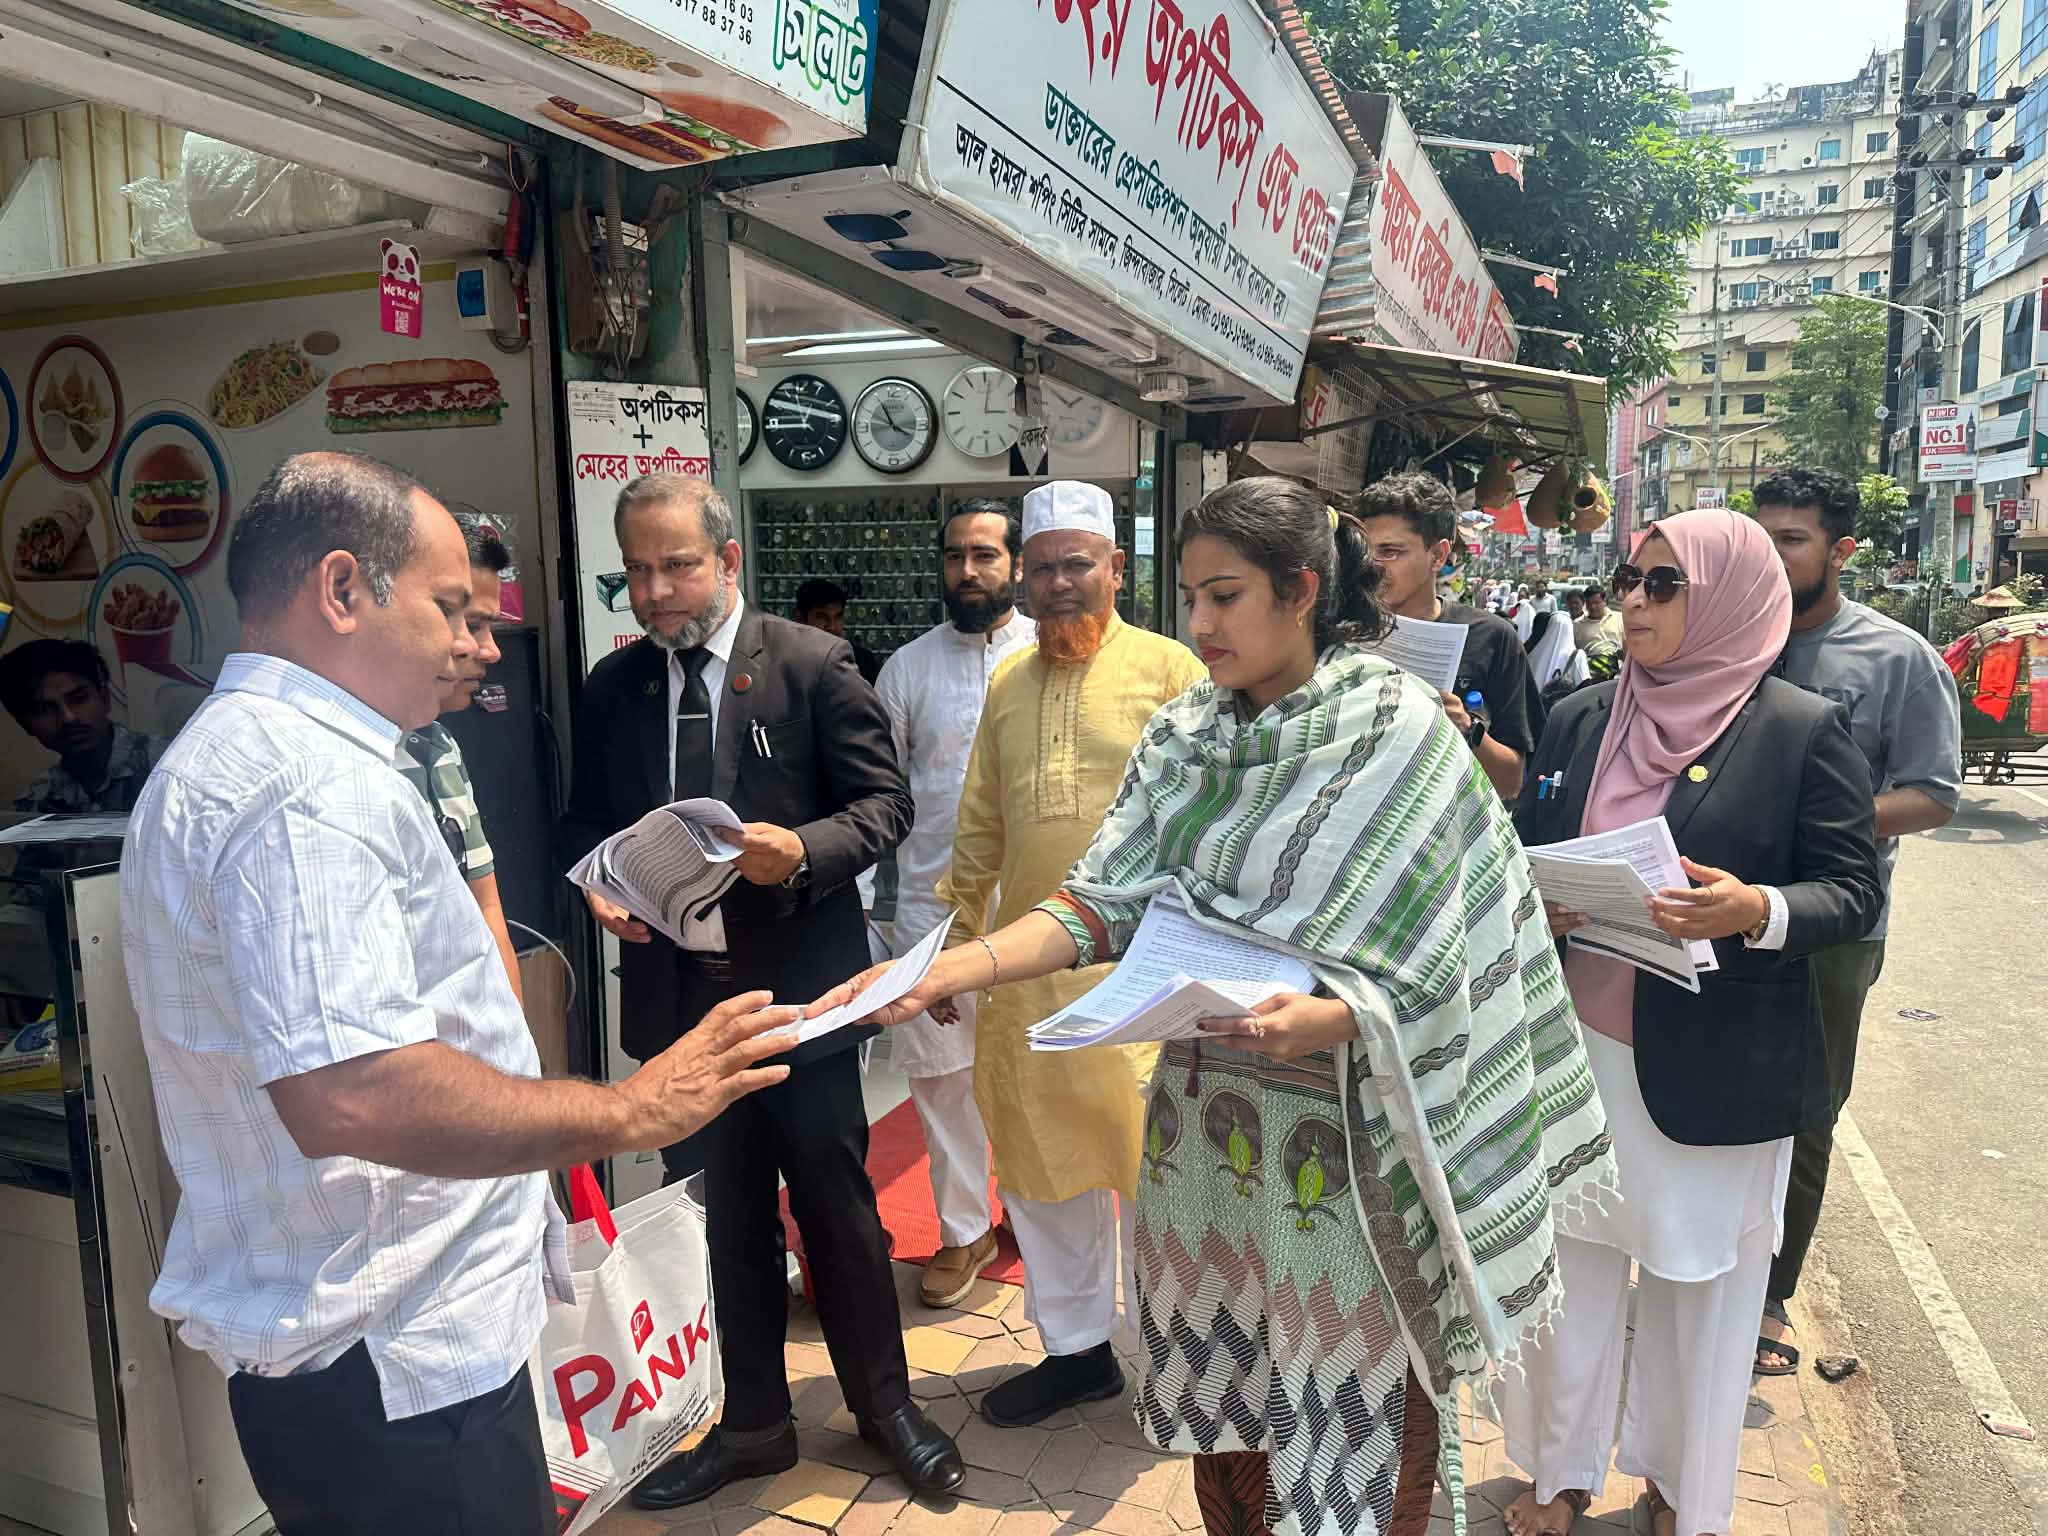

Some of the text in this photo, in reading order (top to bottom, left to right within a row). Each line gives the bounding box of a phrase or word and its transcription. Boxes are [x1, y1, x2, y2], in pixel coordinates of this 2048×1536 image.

[702, 5, 716, 26] 88
[720, 15, 735, 36] 37
[738, 25, 752, 45] 36
[740, 3, 753, 23] 03
[956, 123, 988, 175] আল
[989, 147, 1027, 203] হামরা
[1029, 172, 1057, 225] শপিং
[1056, 188, 1089, 242] সিটির
[1045, 81, 1116, 179] ডাক্তারের
[1115, 151, 1190, 241] প্রেসক্রিপশন
[1189, 210, 1228, 266] অনুযায়ী
[1224, 243, 1250, 290] চশমা
[617, 390, 707, 431] অপটিকস্
[1925, 423, 1964, 445] NO.1
[575, 453, 629, 482] মেহের
